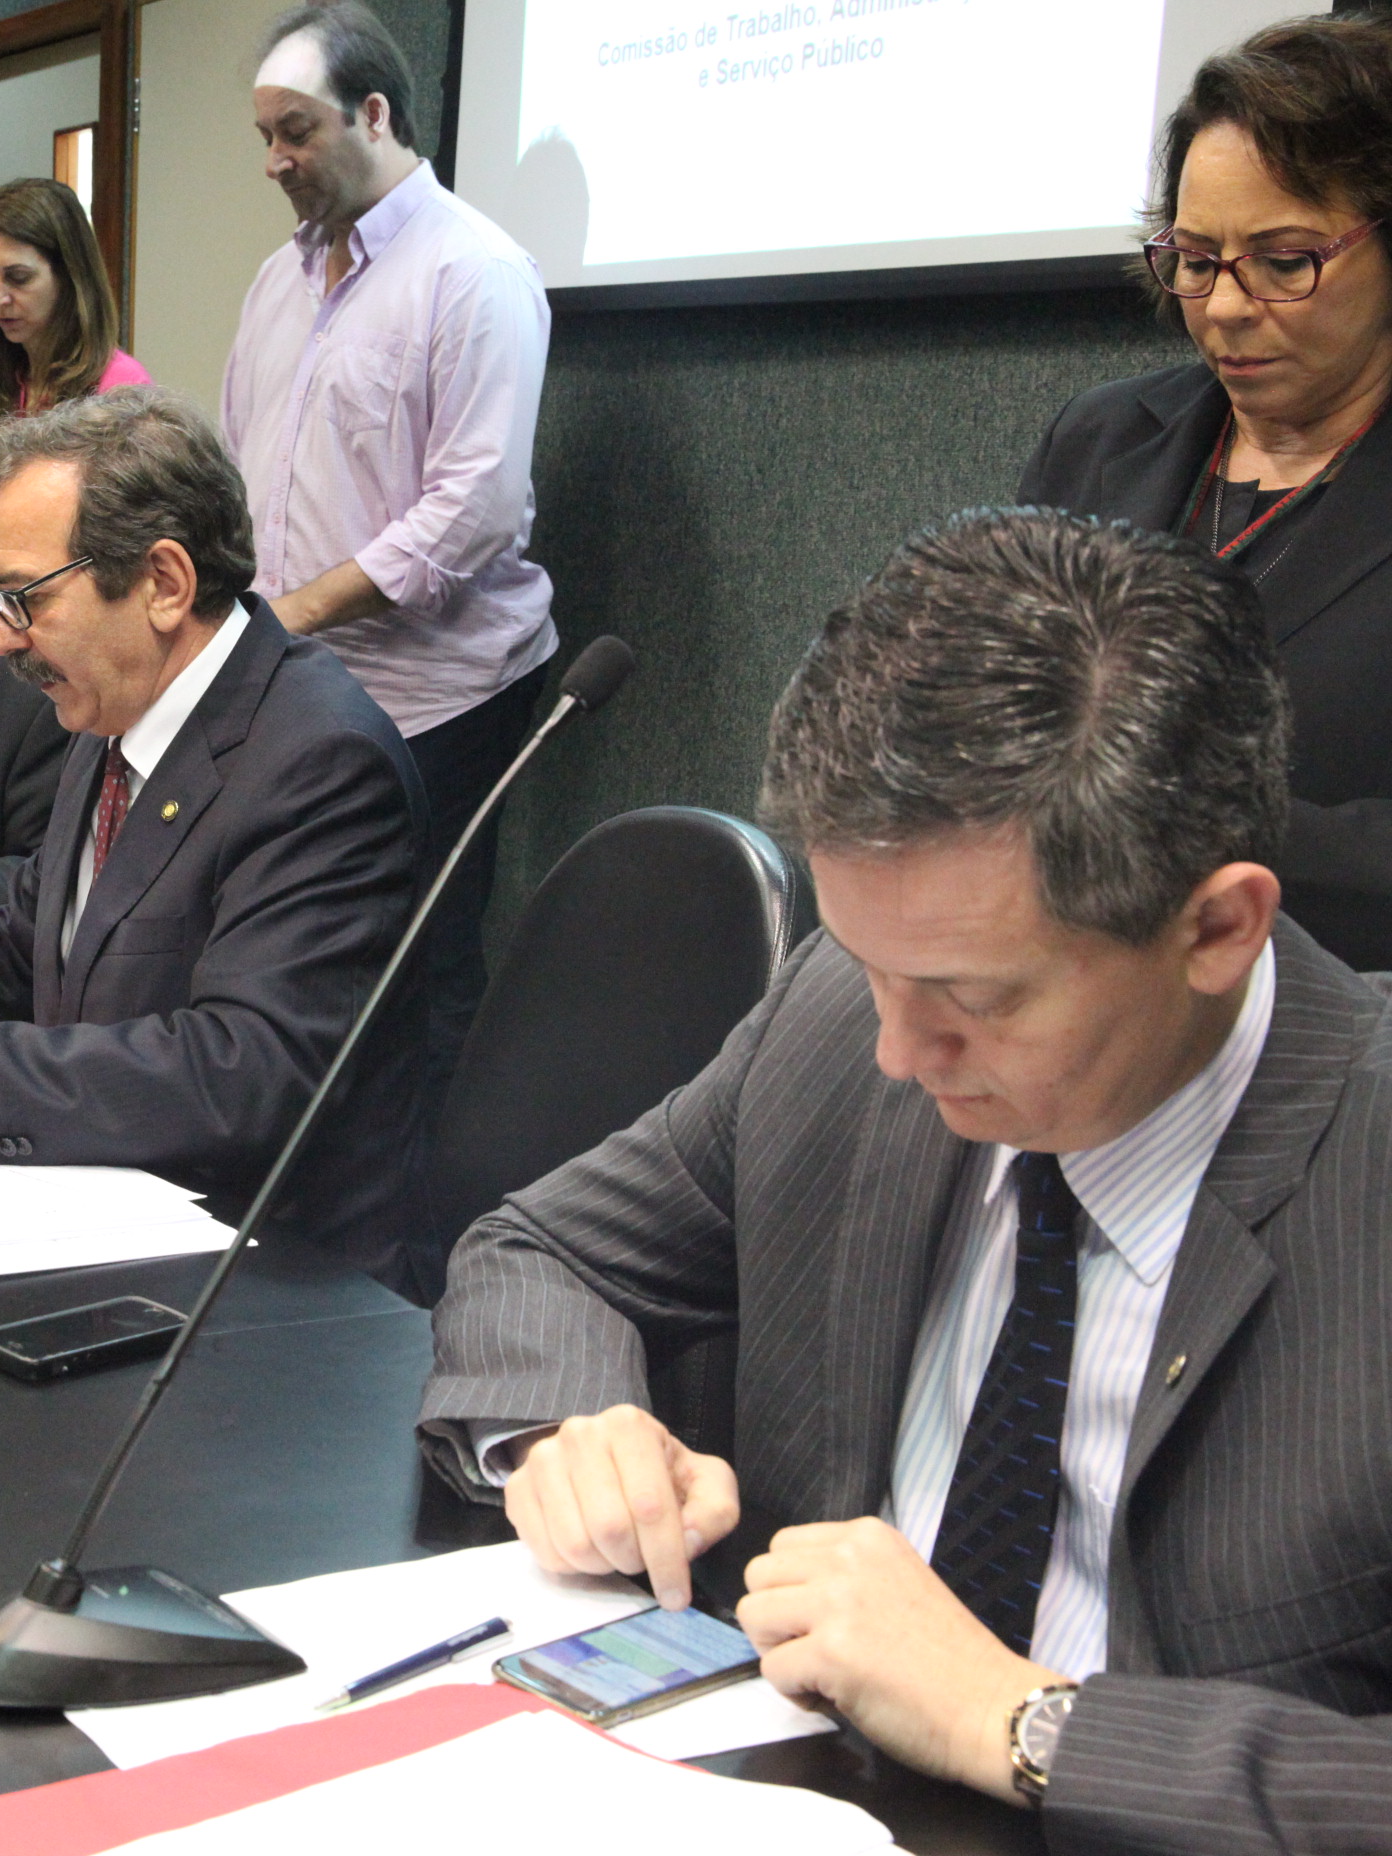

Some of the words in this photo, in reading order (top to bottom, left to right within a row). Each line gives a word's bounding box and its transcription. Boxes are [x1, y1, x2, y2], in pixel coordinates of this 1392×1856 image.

[597, 25, 689, 67] Comissão
[694, 21, 719, 48] de
[697, 68, 710, 88] e
[715, 50, 794, 86] Serviço
[800, 34, 885, 71] Público
